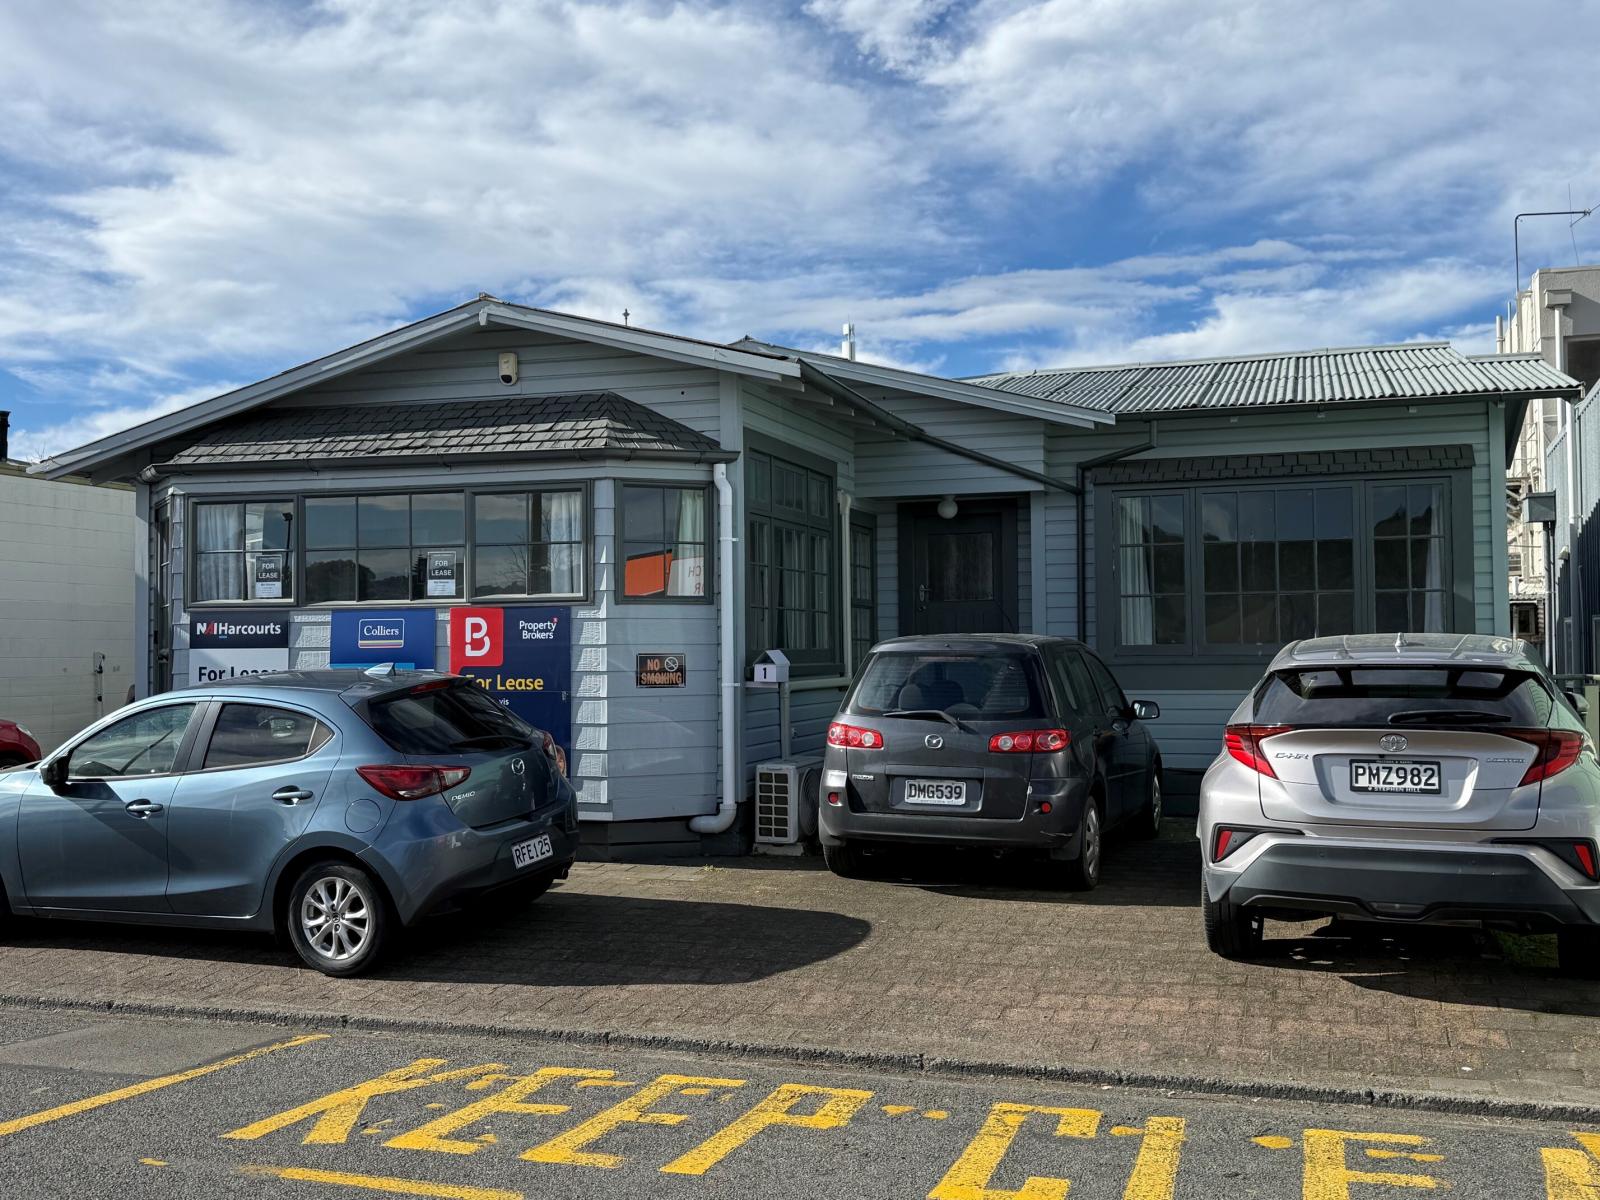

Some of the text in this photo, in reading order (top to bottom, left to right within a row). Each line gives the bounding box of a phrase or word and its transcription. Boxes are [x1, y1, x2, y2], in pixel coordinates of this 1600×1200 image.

[364, 625, 399, 636] Colliers
[519, 620, 556, 631] Property
[465, 617, 490, 656] B
[522, 630, 554, 640] Brokers
[647, 658, 660, 671] NO
[198, 666, 226, 682] For
[641, 672, 682, 685] SMOKING
[763, 667, 767, 679] 1
[466, 674, 544, 690] or Lease
[1354, 765, 1436, 786] PMZ982
[451, 791, 475, 801] DEMIO
[908, 783, 962, 800] DMG539
[514, 838, 551, 864] RFE125
[219, 1058, 875, 1176] KEEP
